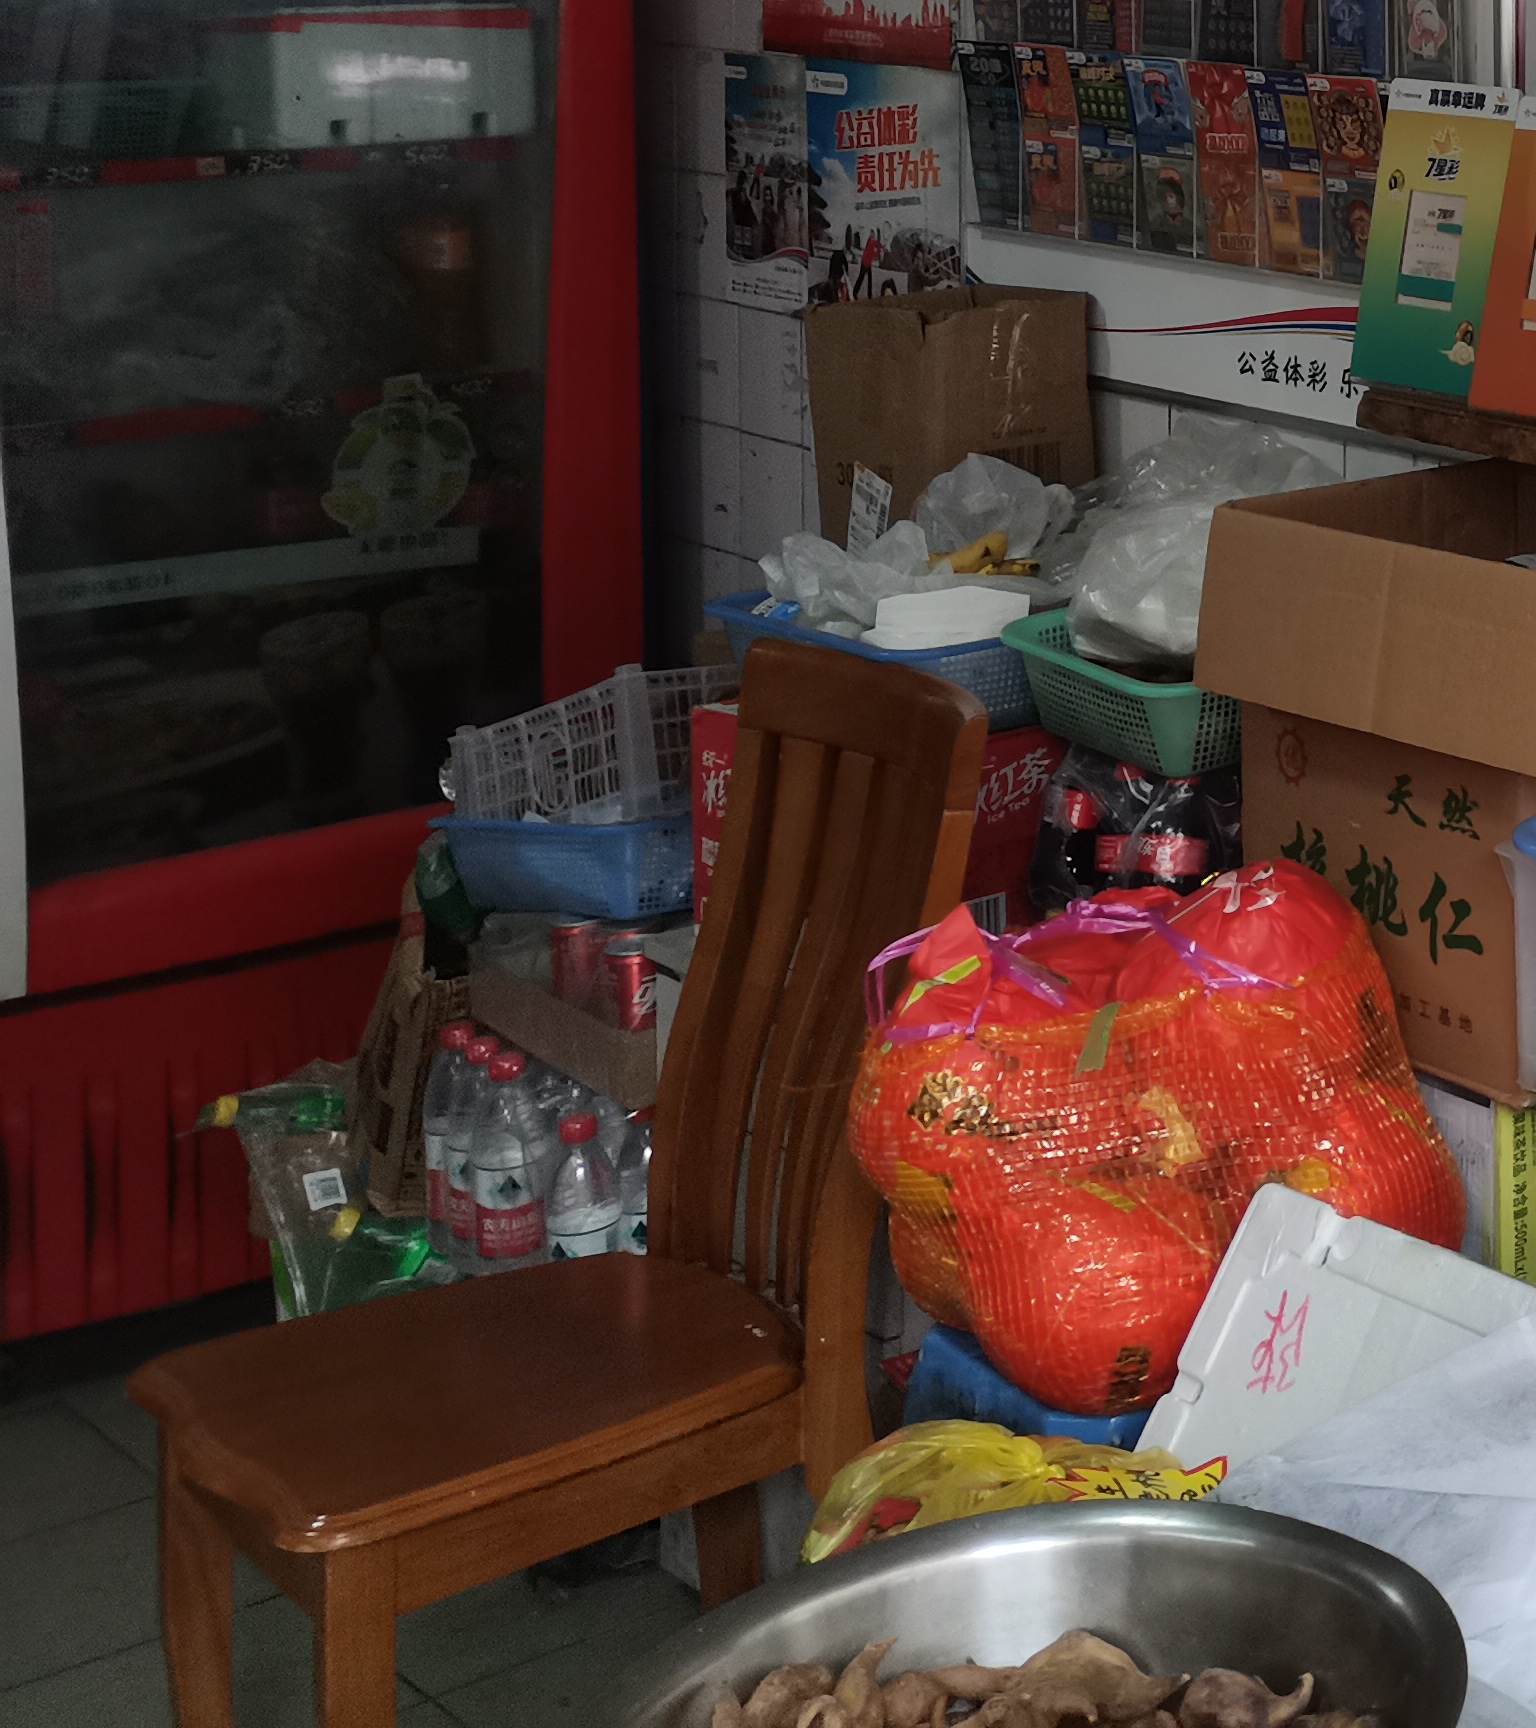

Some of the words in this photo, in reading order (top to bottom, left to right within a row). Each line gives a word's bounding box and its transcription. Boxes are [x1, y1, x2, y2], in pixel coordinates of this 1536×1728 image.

[1429, 88, 1486, 111] 真票幸运牌
[835, 104, 918, 151] 公益体彩
[856, 148, 941, 194] 责任为先
[1425, 157, 1460, 181] 7星彩
[1237, 349, 1328, 394] 公益体彩
[1386, 774, 1481, 841] 天然
